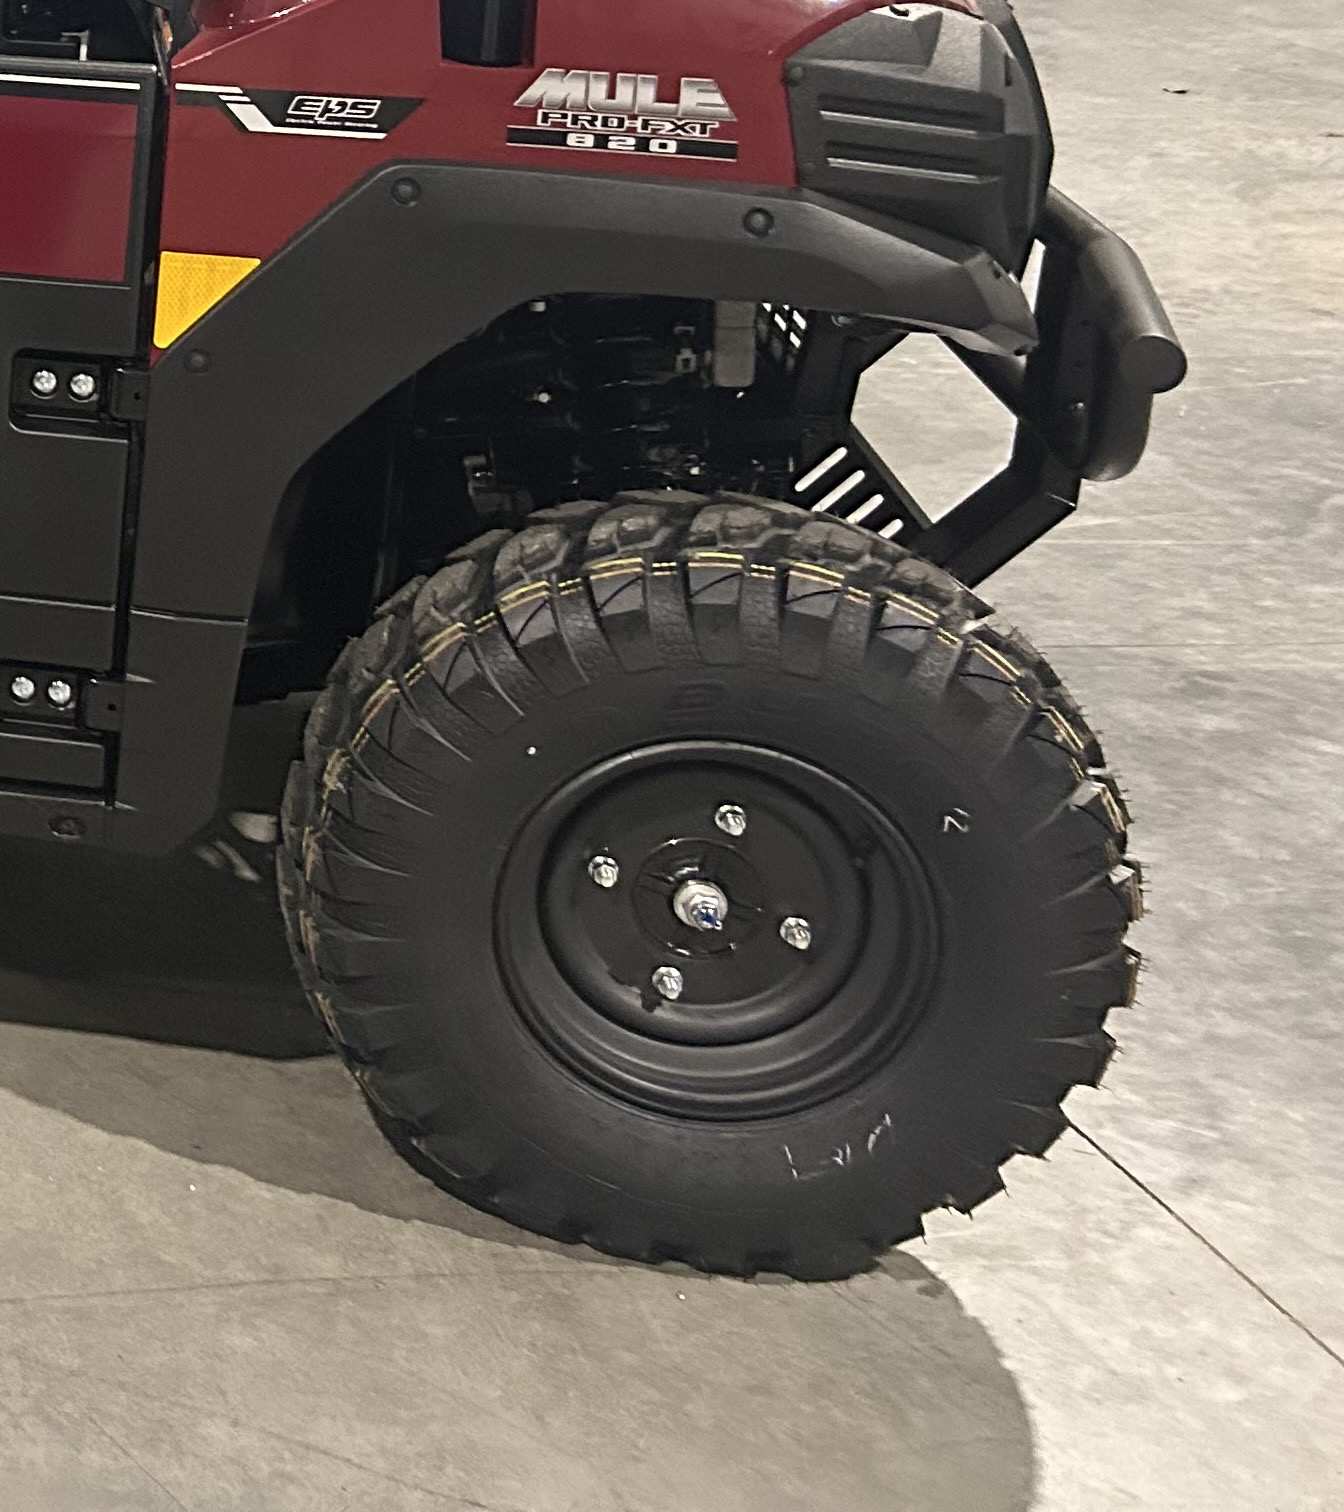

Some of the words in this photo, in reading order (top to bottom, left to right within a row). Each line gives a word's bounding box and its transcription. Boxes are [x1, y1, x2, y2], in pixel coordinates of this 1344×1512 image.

[513, 67, 738, 122] MULE
[536, 108, 720, 138] PRO-FXT
[565, 133, 678, 154] 820
